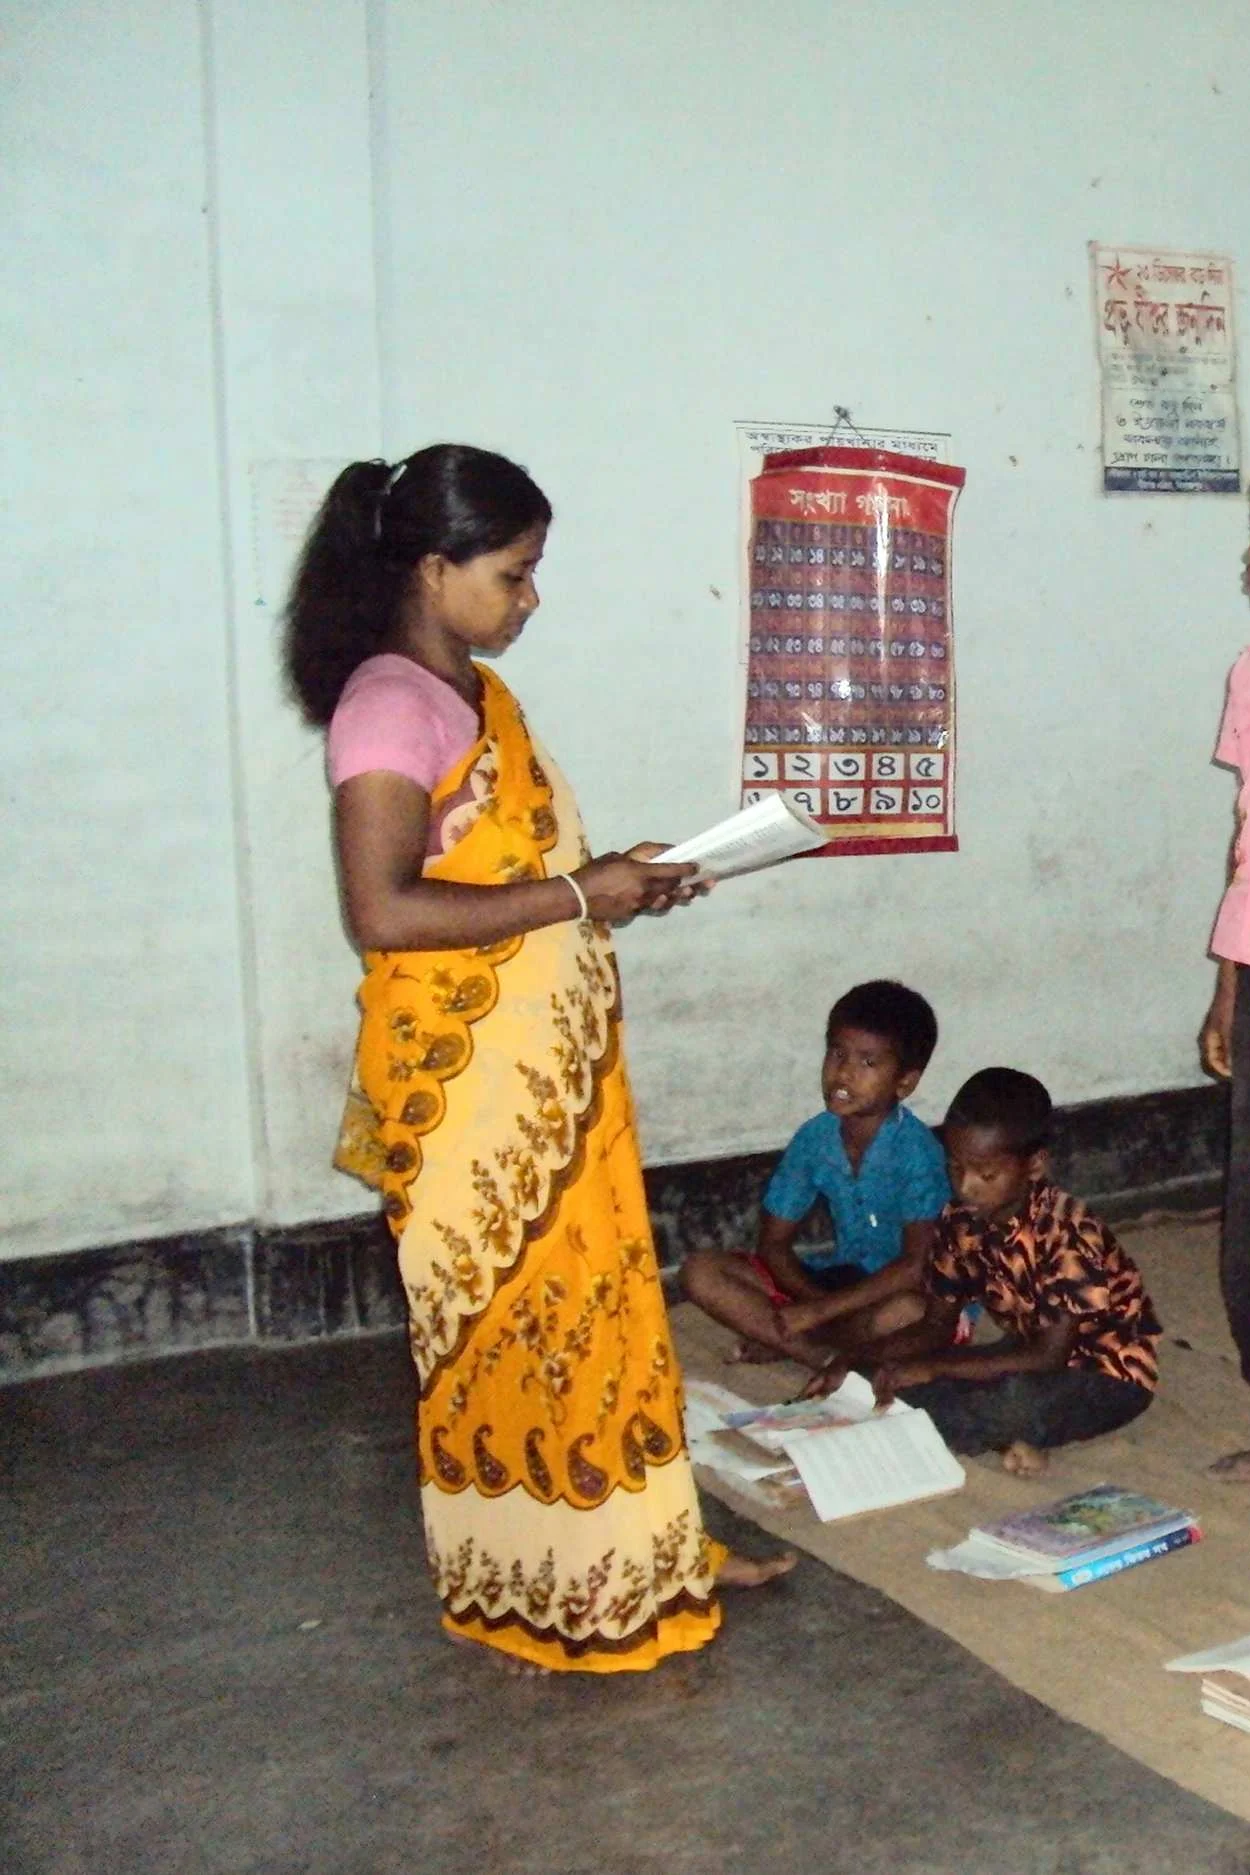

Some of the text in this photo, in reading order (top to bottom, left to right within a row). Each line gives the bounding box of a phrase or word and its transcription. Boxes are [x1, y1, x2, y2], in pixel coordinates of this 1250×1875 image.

[788, 488, 848, 516] সংখ্যা
[809, 547, 824, 564] ১৪
[808, 592, 824, 608] ৩৪
[752, 755, 935, 778] ১ ২ ৩ ৪ ৫
[794, 789, 941, 812] ৭ ৮ ৯ ১০
